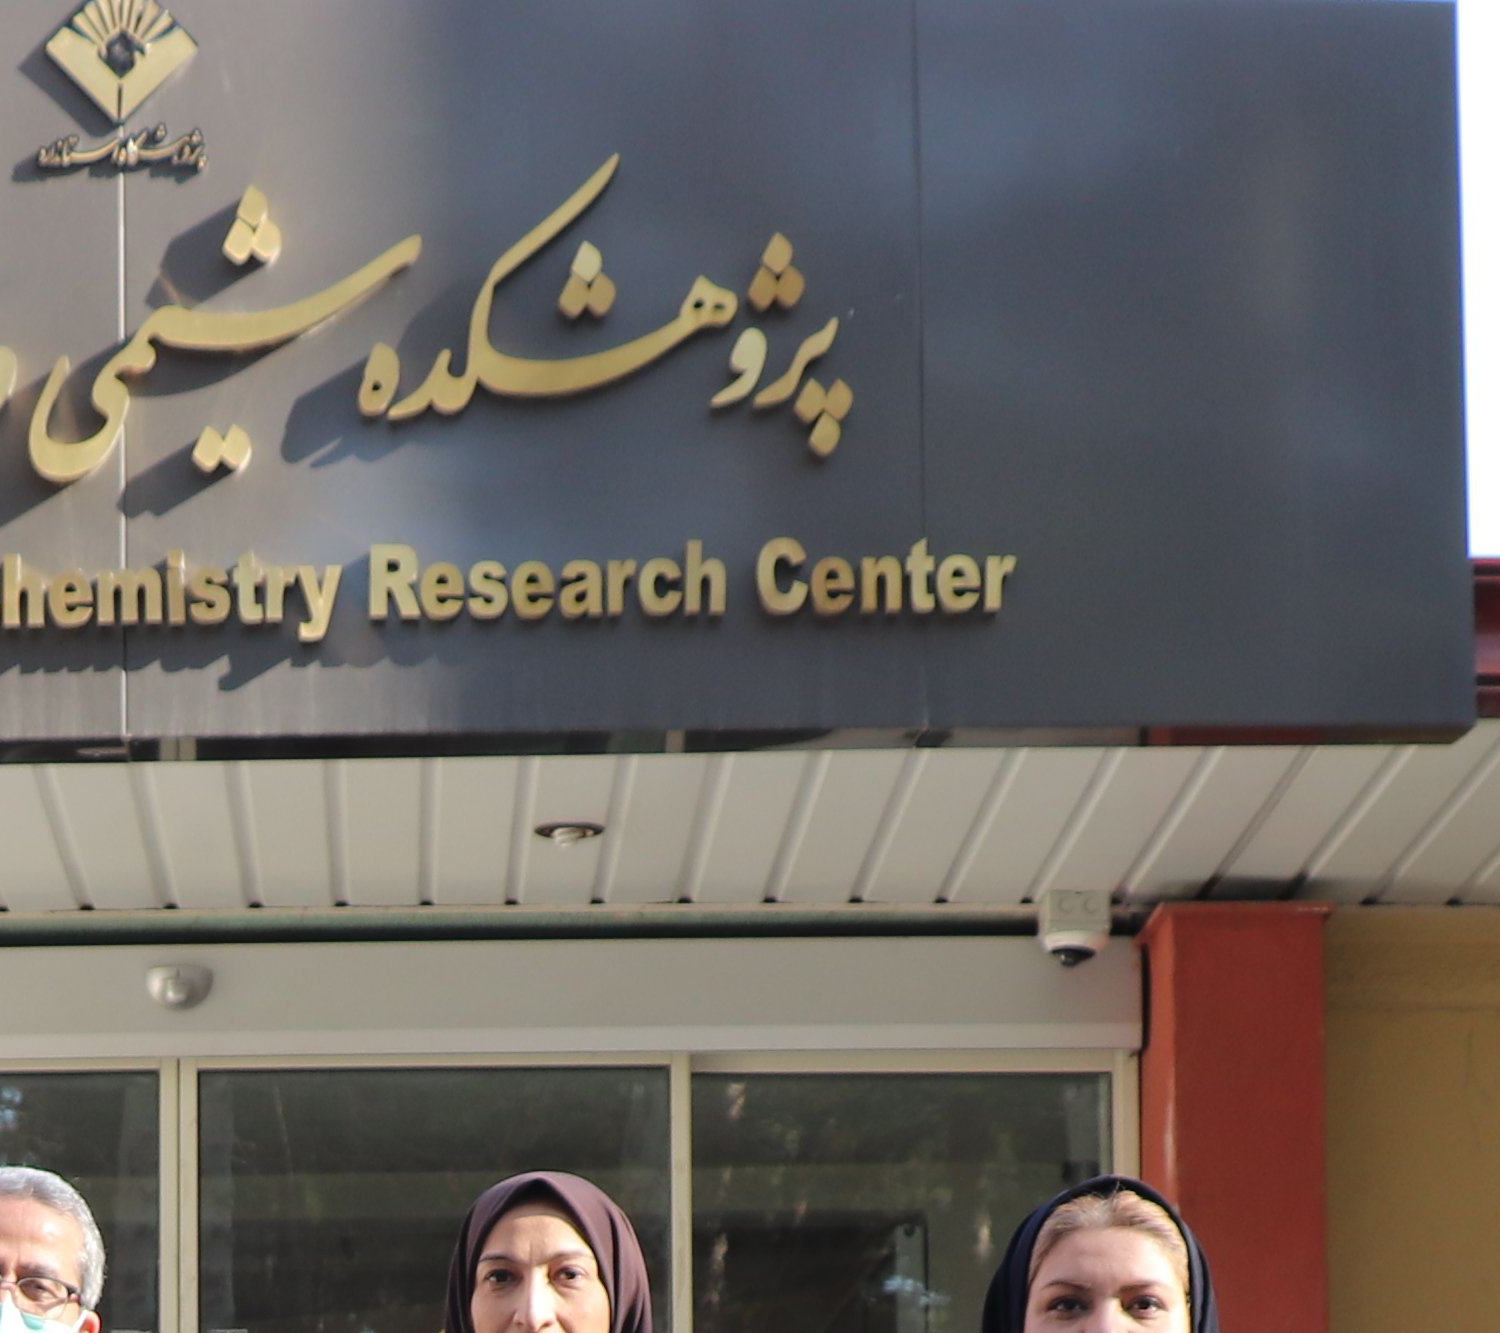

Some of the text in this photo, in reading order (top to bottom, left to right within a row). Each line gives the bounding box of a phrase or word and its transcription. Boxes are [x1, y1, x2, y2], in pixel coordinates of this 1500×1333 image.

[28, 184, 423, 484] شیمی
[357, 153, 853, 458] پژوهشکده
[367, 539, 728, 624] Research
[755, 536, 1017, 618] Center
